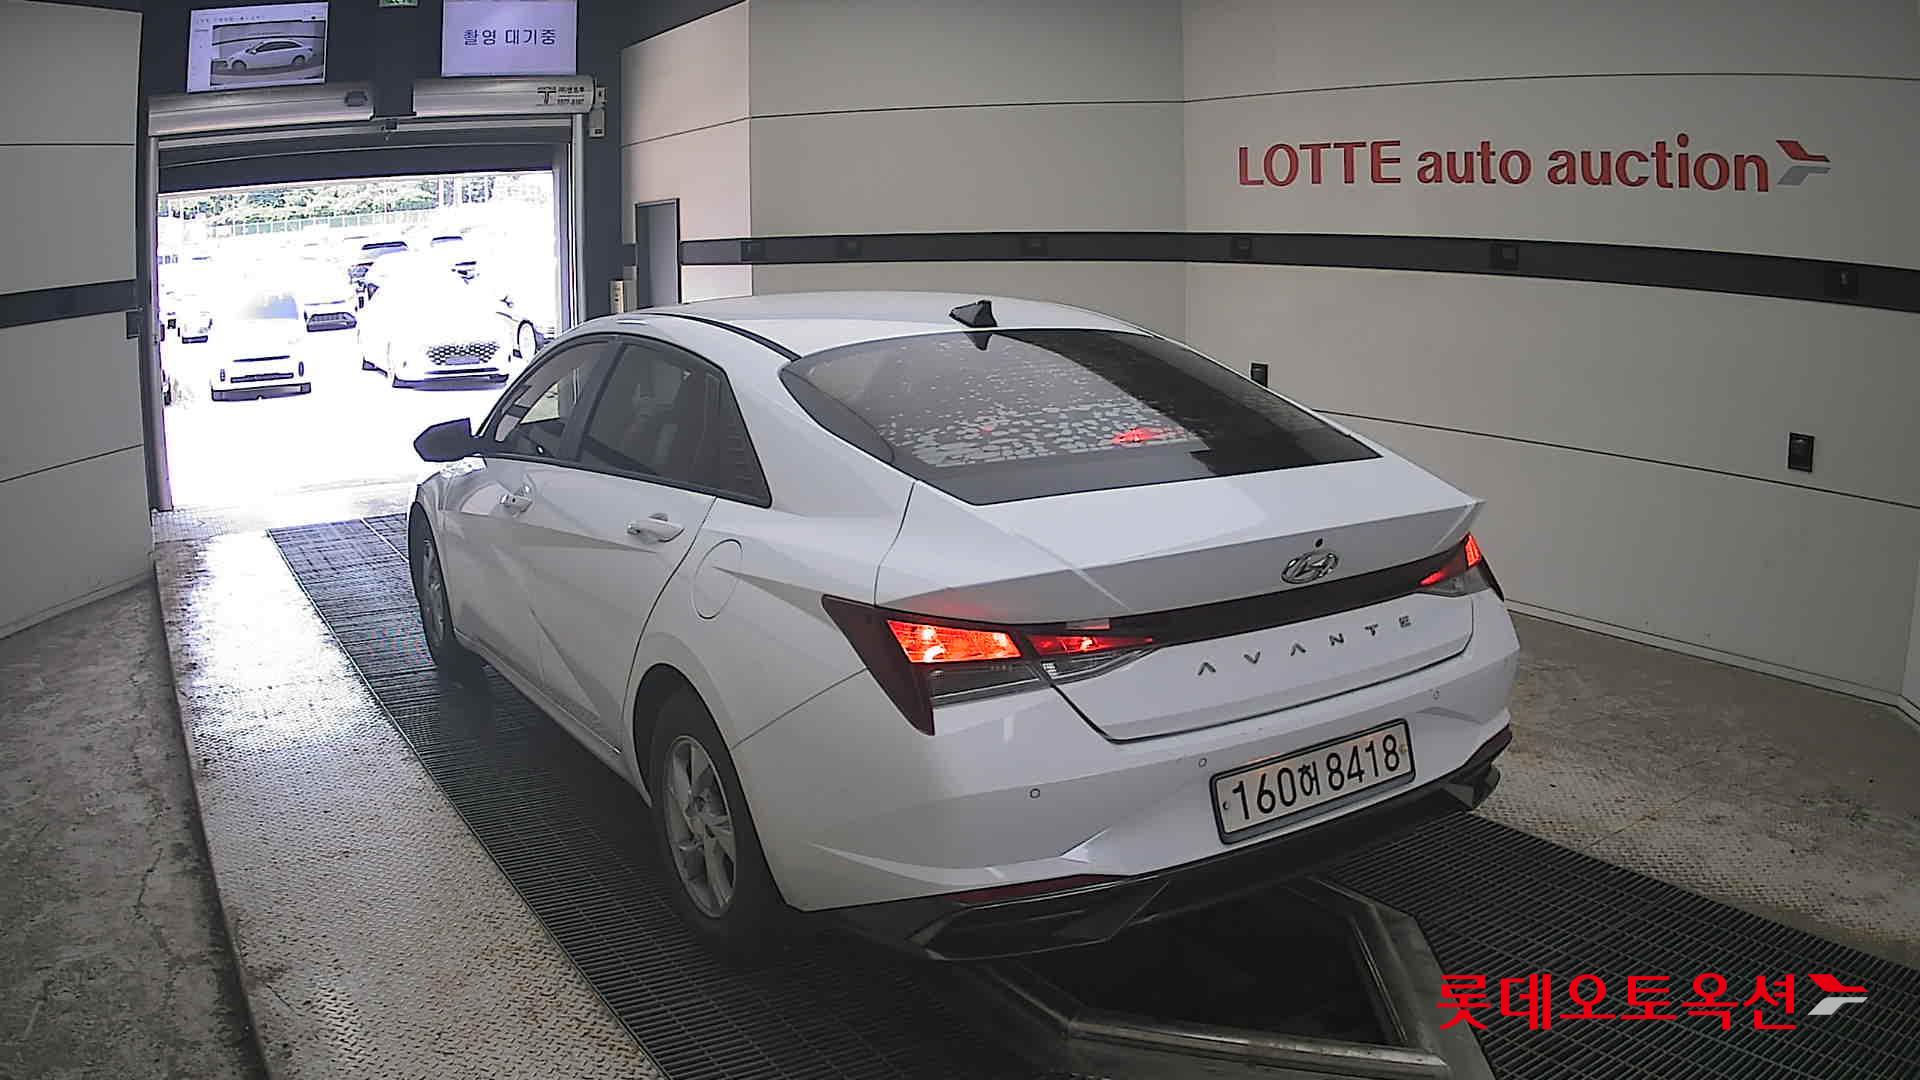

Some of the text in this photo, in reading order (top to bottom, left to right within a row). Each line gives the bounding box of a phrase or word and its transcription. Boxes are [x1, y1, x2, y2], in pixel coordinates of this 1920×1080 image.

[464, 29, 557, 46] 촬영 대기중
[1238, 133, 1770, 192] LOTTE auto auction
[1198, 615, 1412, 676] AVANTE
